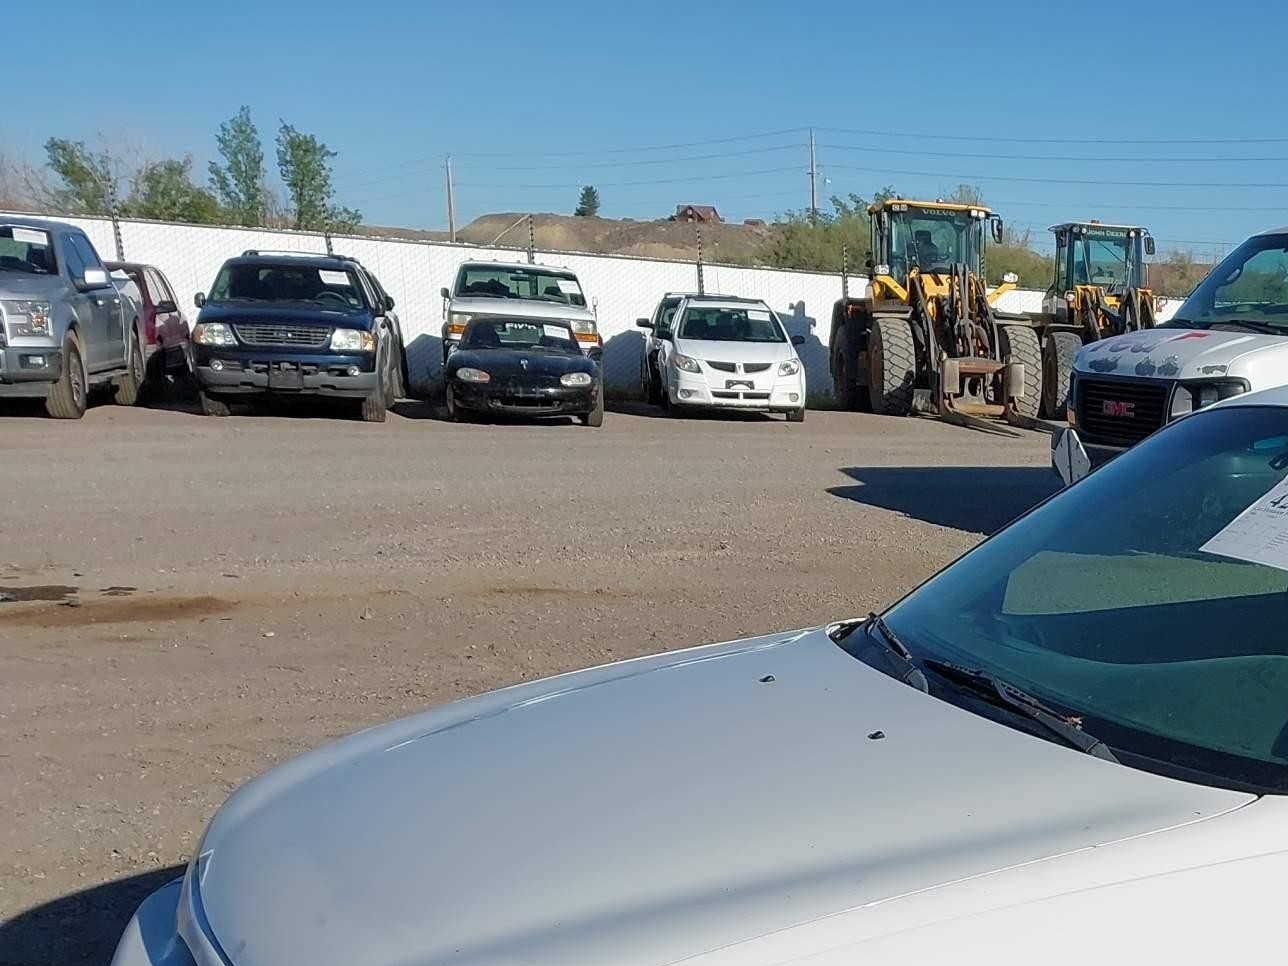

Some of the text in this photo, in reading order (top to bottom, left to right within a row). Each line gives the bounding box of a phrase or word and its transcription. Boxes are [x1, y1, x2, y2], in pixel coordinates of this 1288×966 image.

[921, 209, 956, 217] VOLVO
[1087, 228, 1105, 237] JOHN
[1102, 400, 1135, 417] GMC
